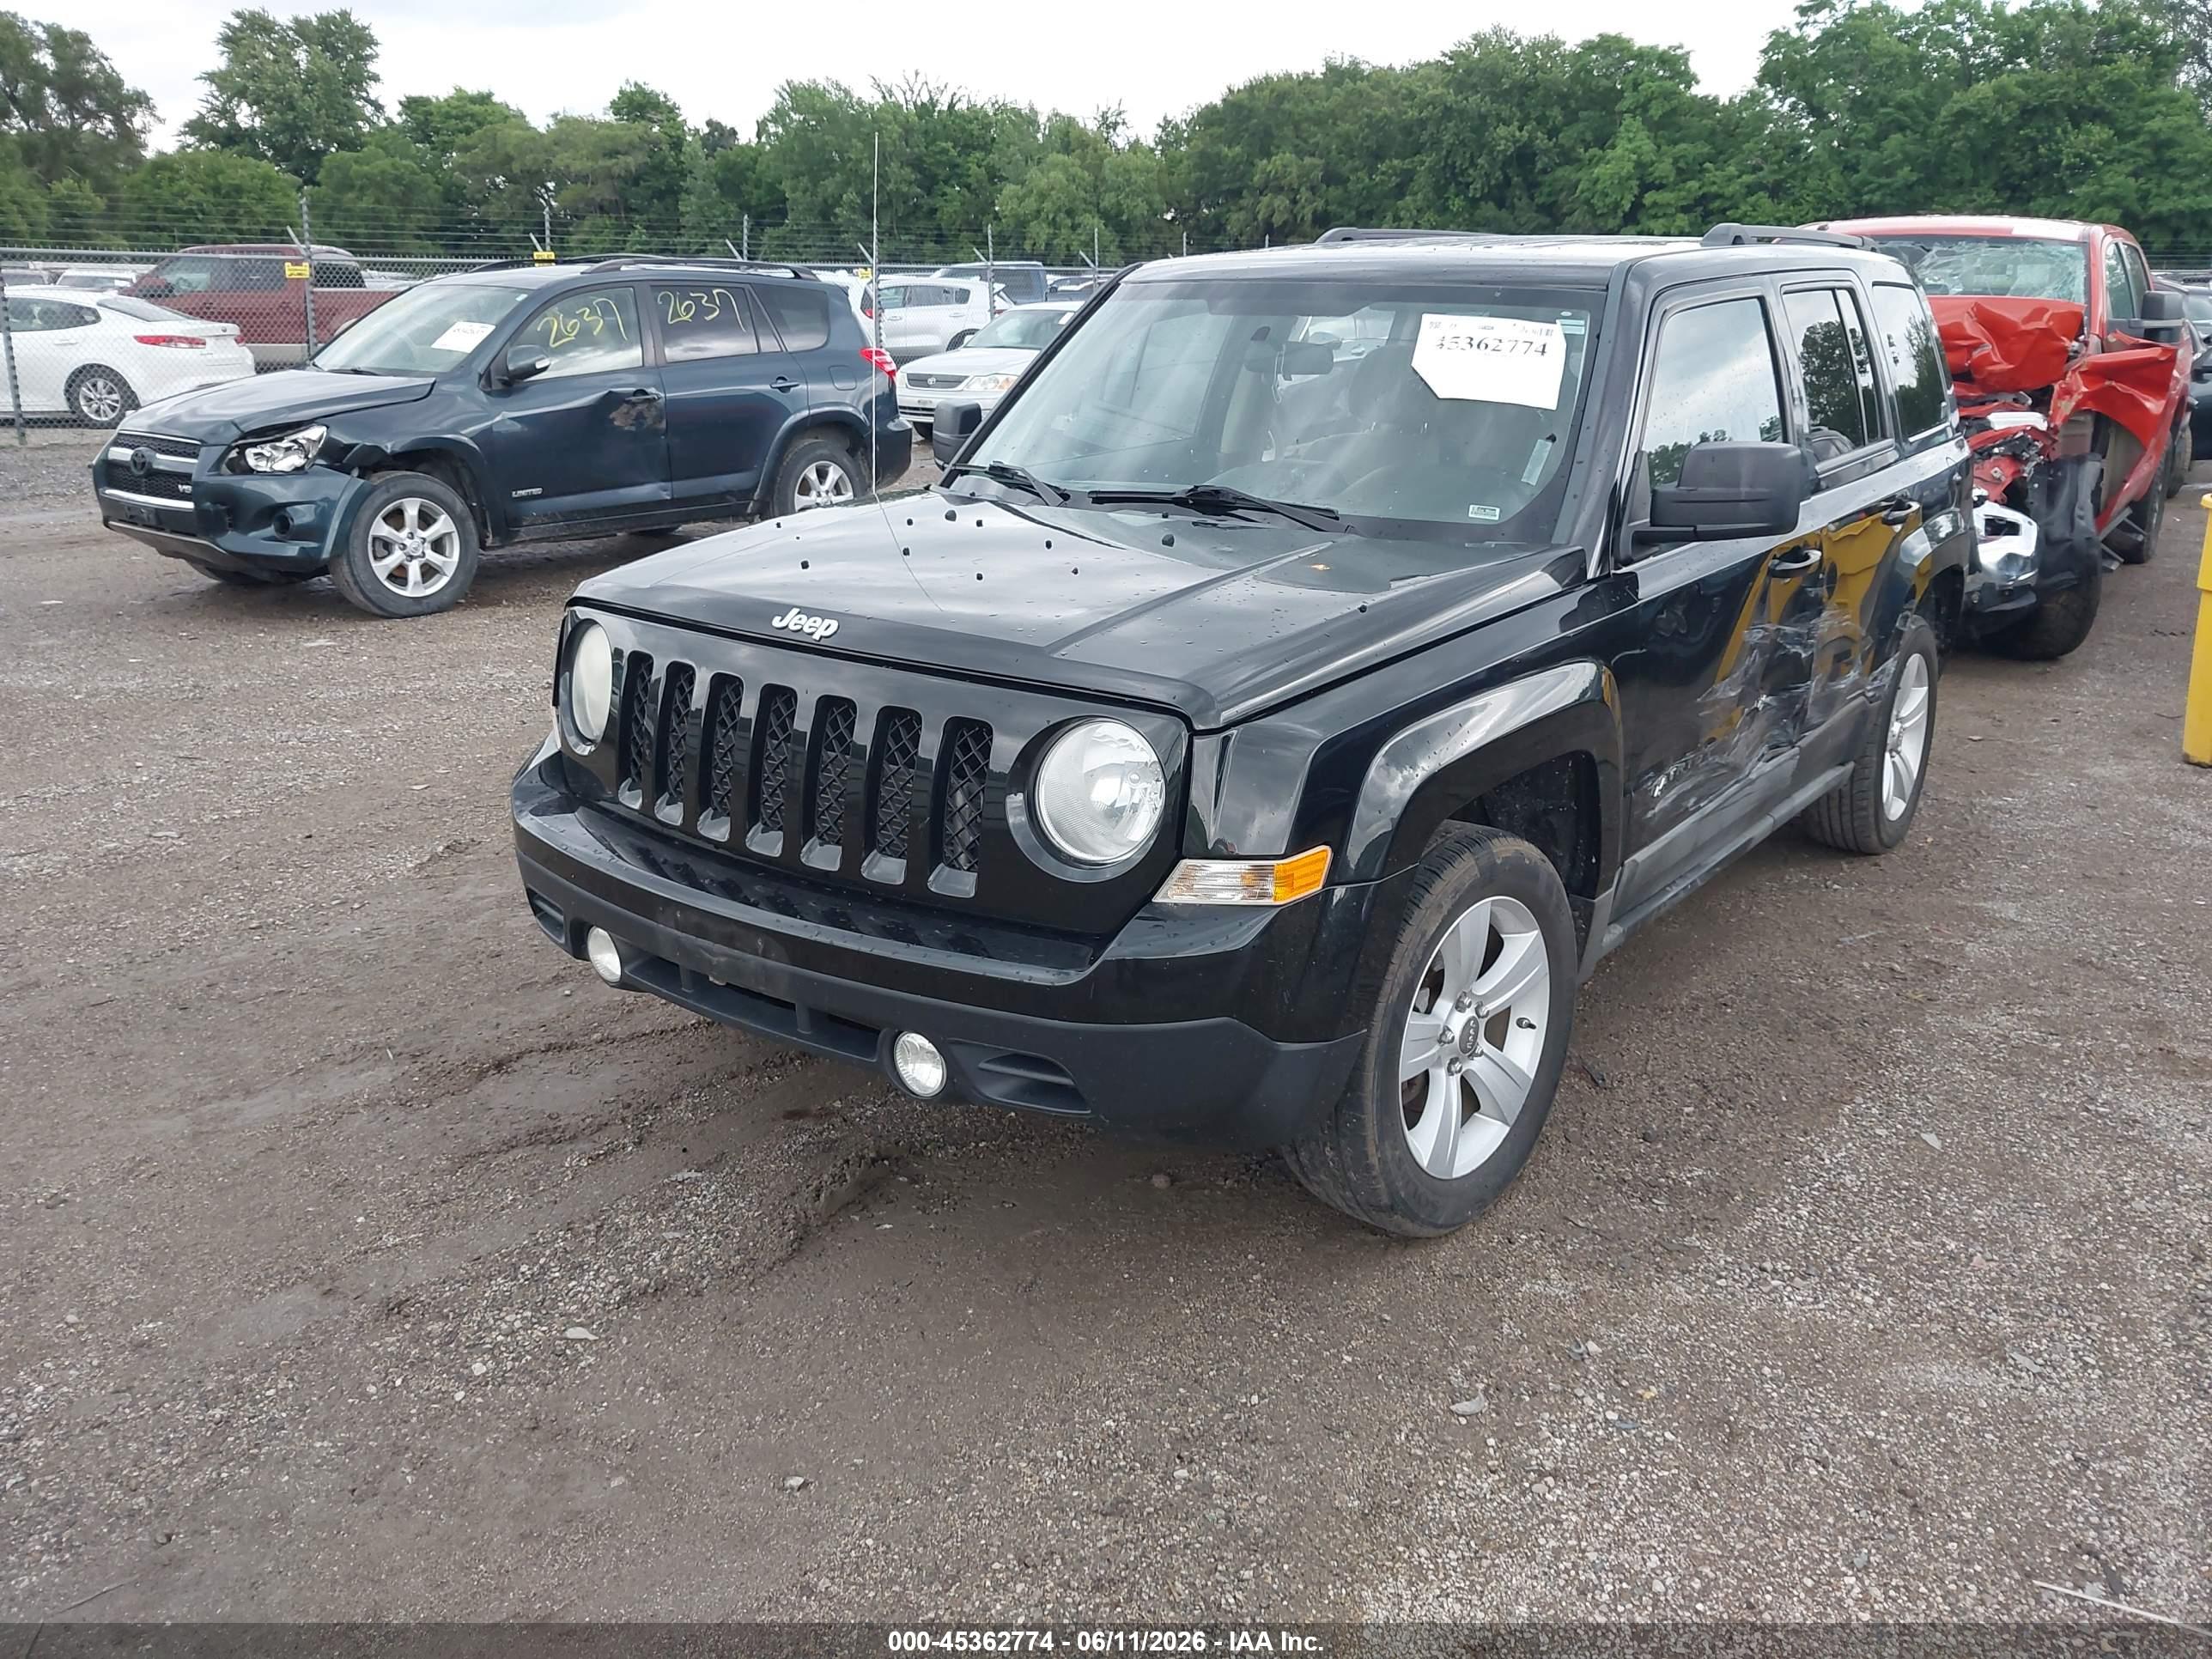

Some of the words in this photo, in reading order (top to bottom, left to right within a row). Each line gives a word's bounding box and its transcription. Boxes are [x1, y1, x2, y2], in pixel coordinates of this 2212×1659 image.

[537, 297, 629, 348] 2637
[658, 289, 746, 333] 2637
[771, 607, 839, 641] Jeep
